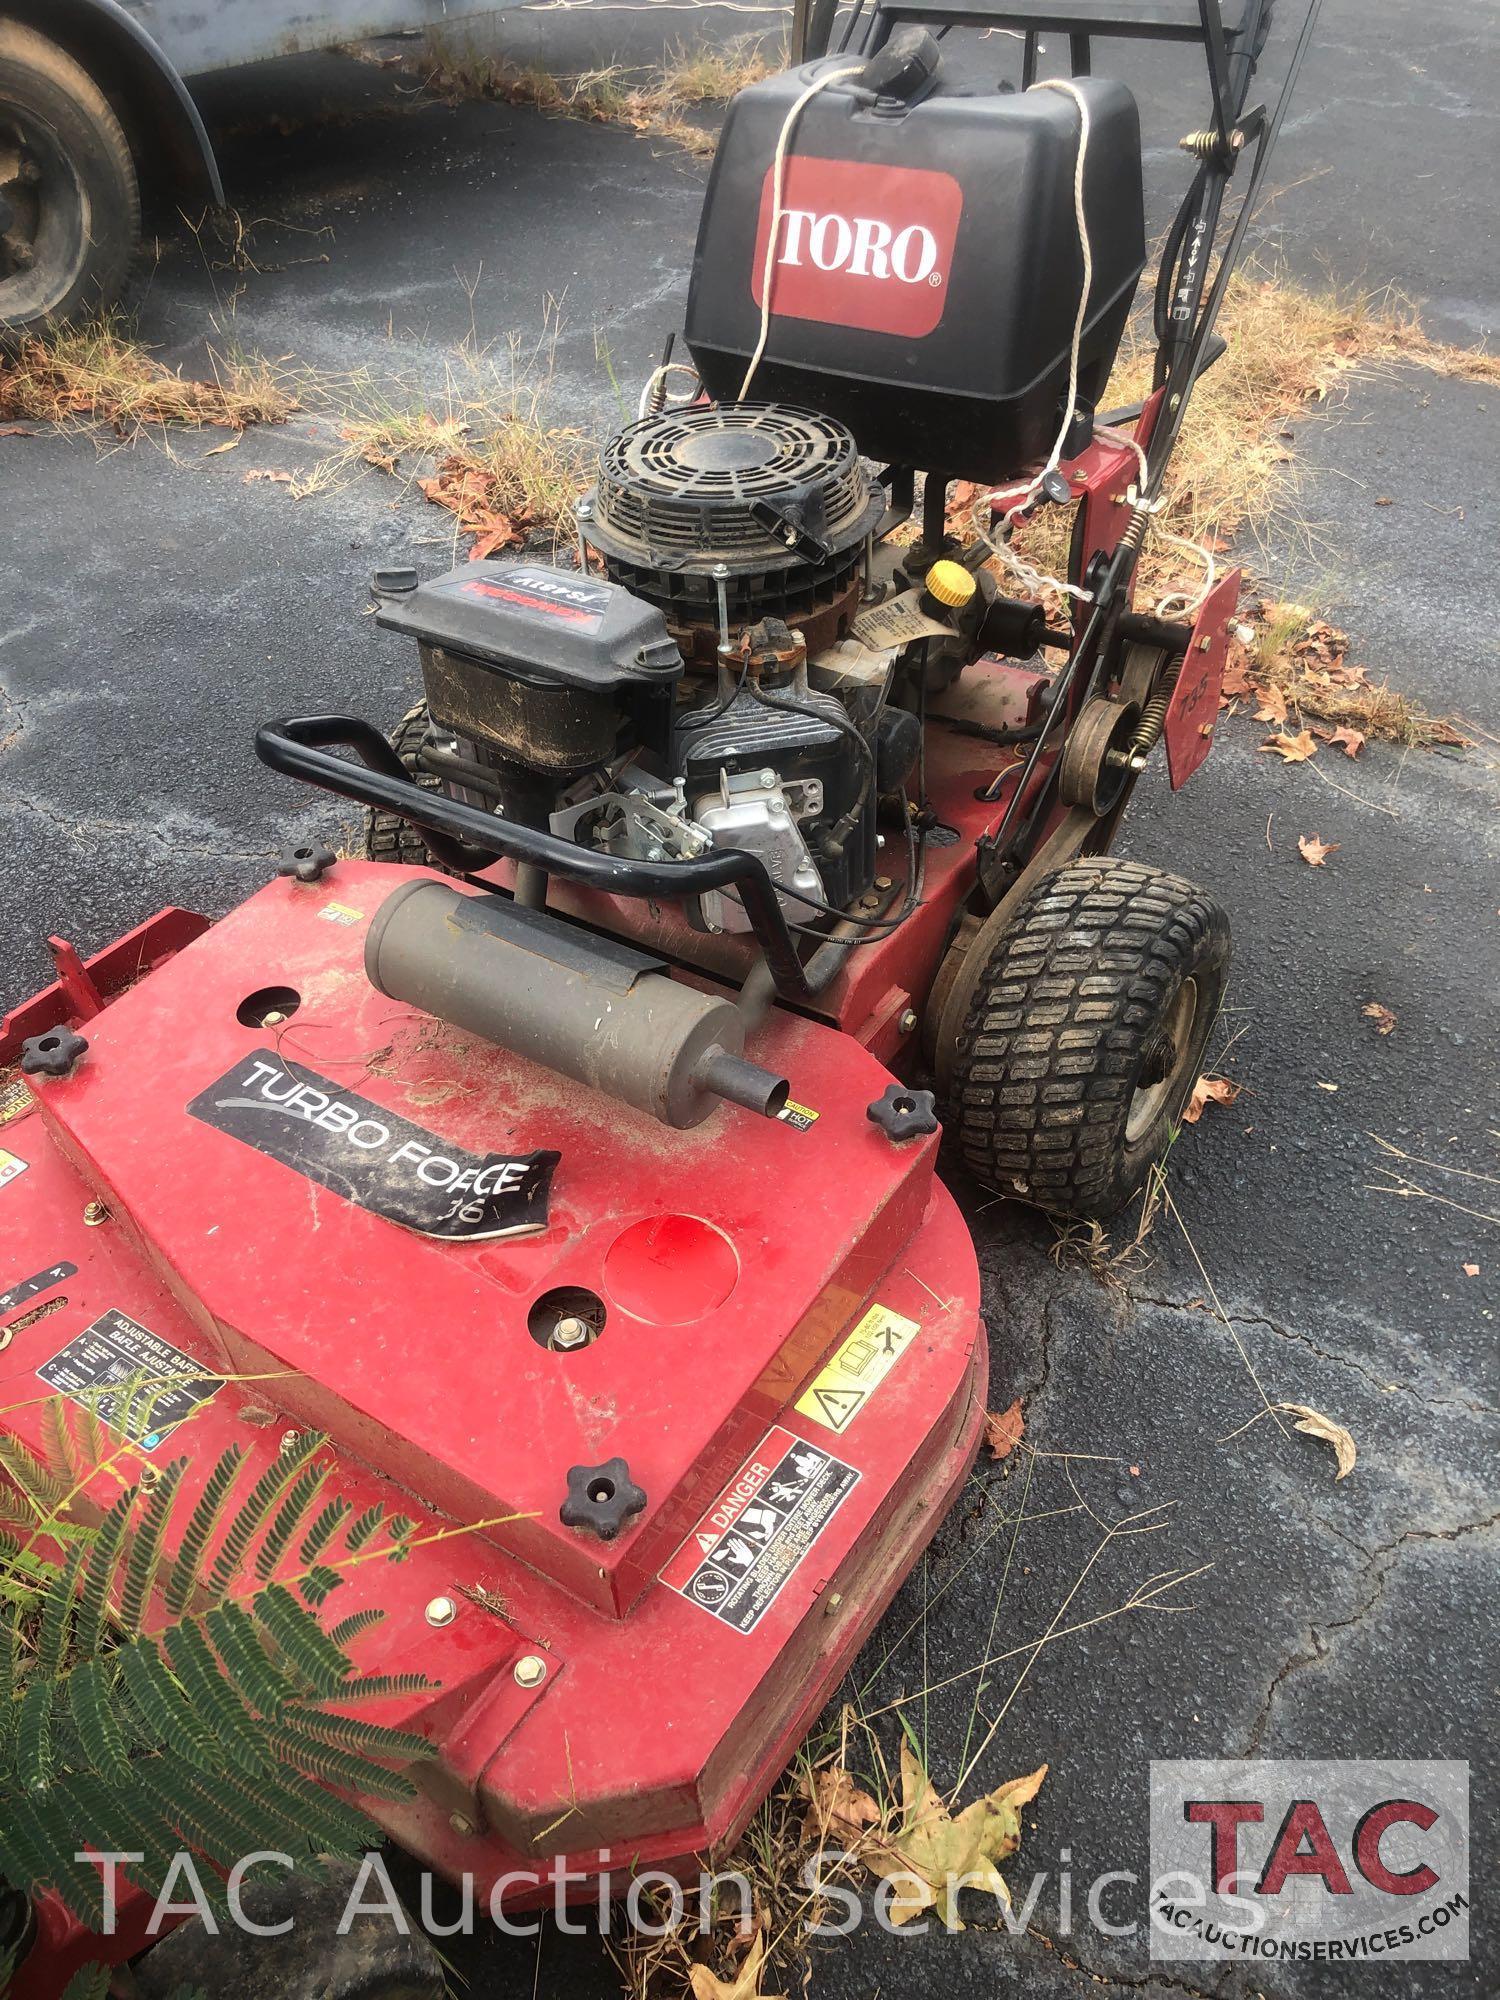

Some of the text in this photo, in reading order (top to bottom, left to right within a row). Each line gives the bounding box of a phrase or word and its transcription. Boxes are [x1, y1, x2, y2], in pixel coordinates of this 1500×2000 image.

[777, 209, 937, 284] TORO
[241, 1061, 390, 1149] TURBO
[787, 1101, 815, 1117] CAUTION
[790, 1112, 812, 1125] HOT
[108, 1330, 141, 1353] BAFLE
[114, 1319, 171, 1357] ADJUSTABLE
[711, 1462, 770, 1527] DANGER
[727, 1469, 833, 1609] ROTATING BLADES UNDER ENTIRE MOWER DECK.
[738, 1608, 756, 1628] KEEP
[751, 1572, 783, 1610] DEFLECTOR
[778, 1564, 787, 1573] IN
[799, 1526, 815, 1544] KEEP
[811, 1487, 843, 1527] BYSTANDERS
[839, 1470, 855, 1488] AWAY.
[752, 1570, 775, 1598] THROWN
[771, 1542, 796, 1571] OBJECTS
[792, 1528, 805, 1543] ARE
[801, 1490, 833, 1529] DANGEROUS.
[754, 1565, 770, 1582] KEEP
[767, 1543, 786, 1565] HANDS
[783, 1532, 795, 1544] and
[791, 1516, 806, 1532] FEET
